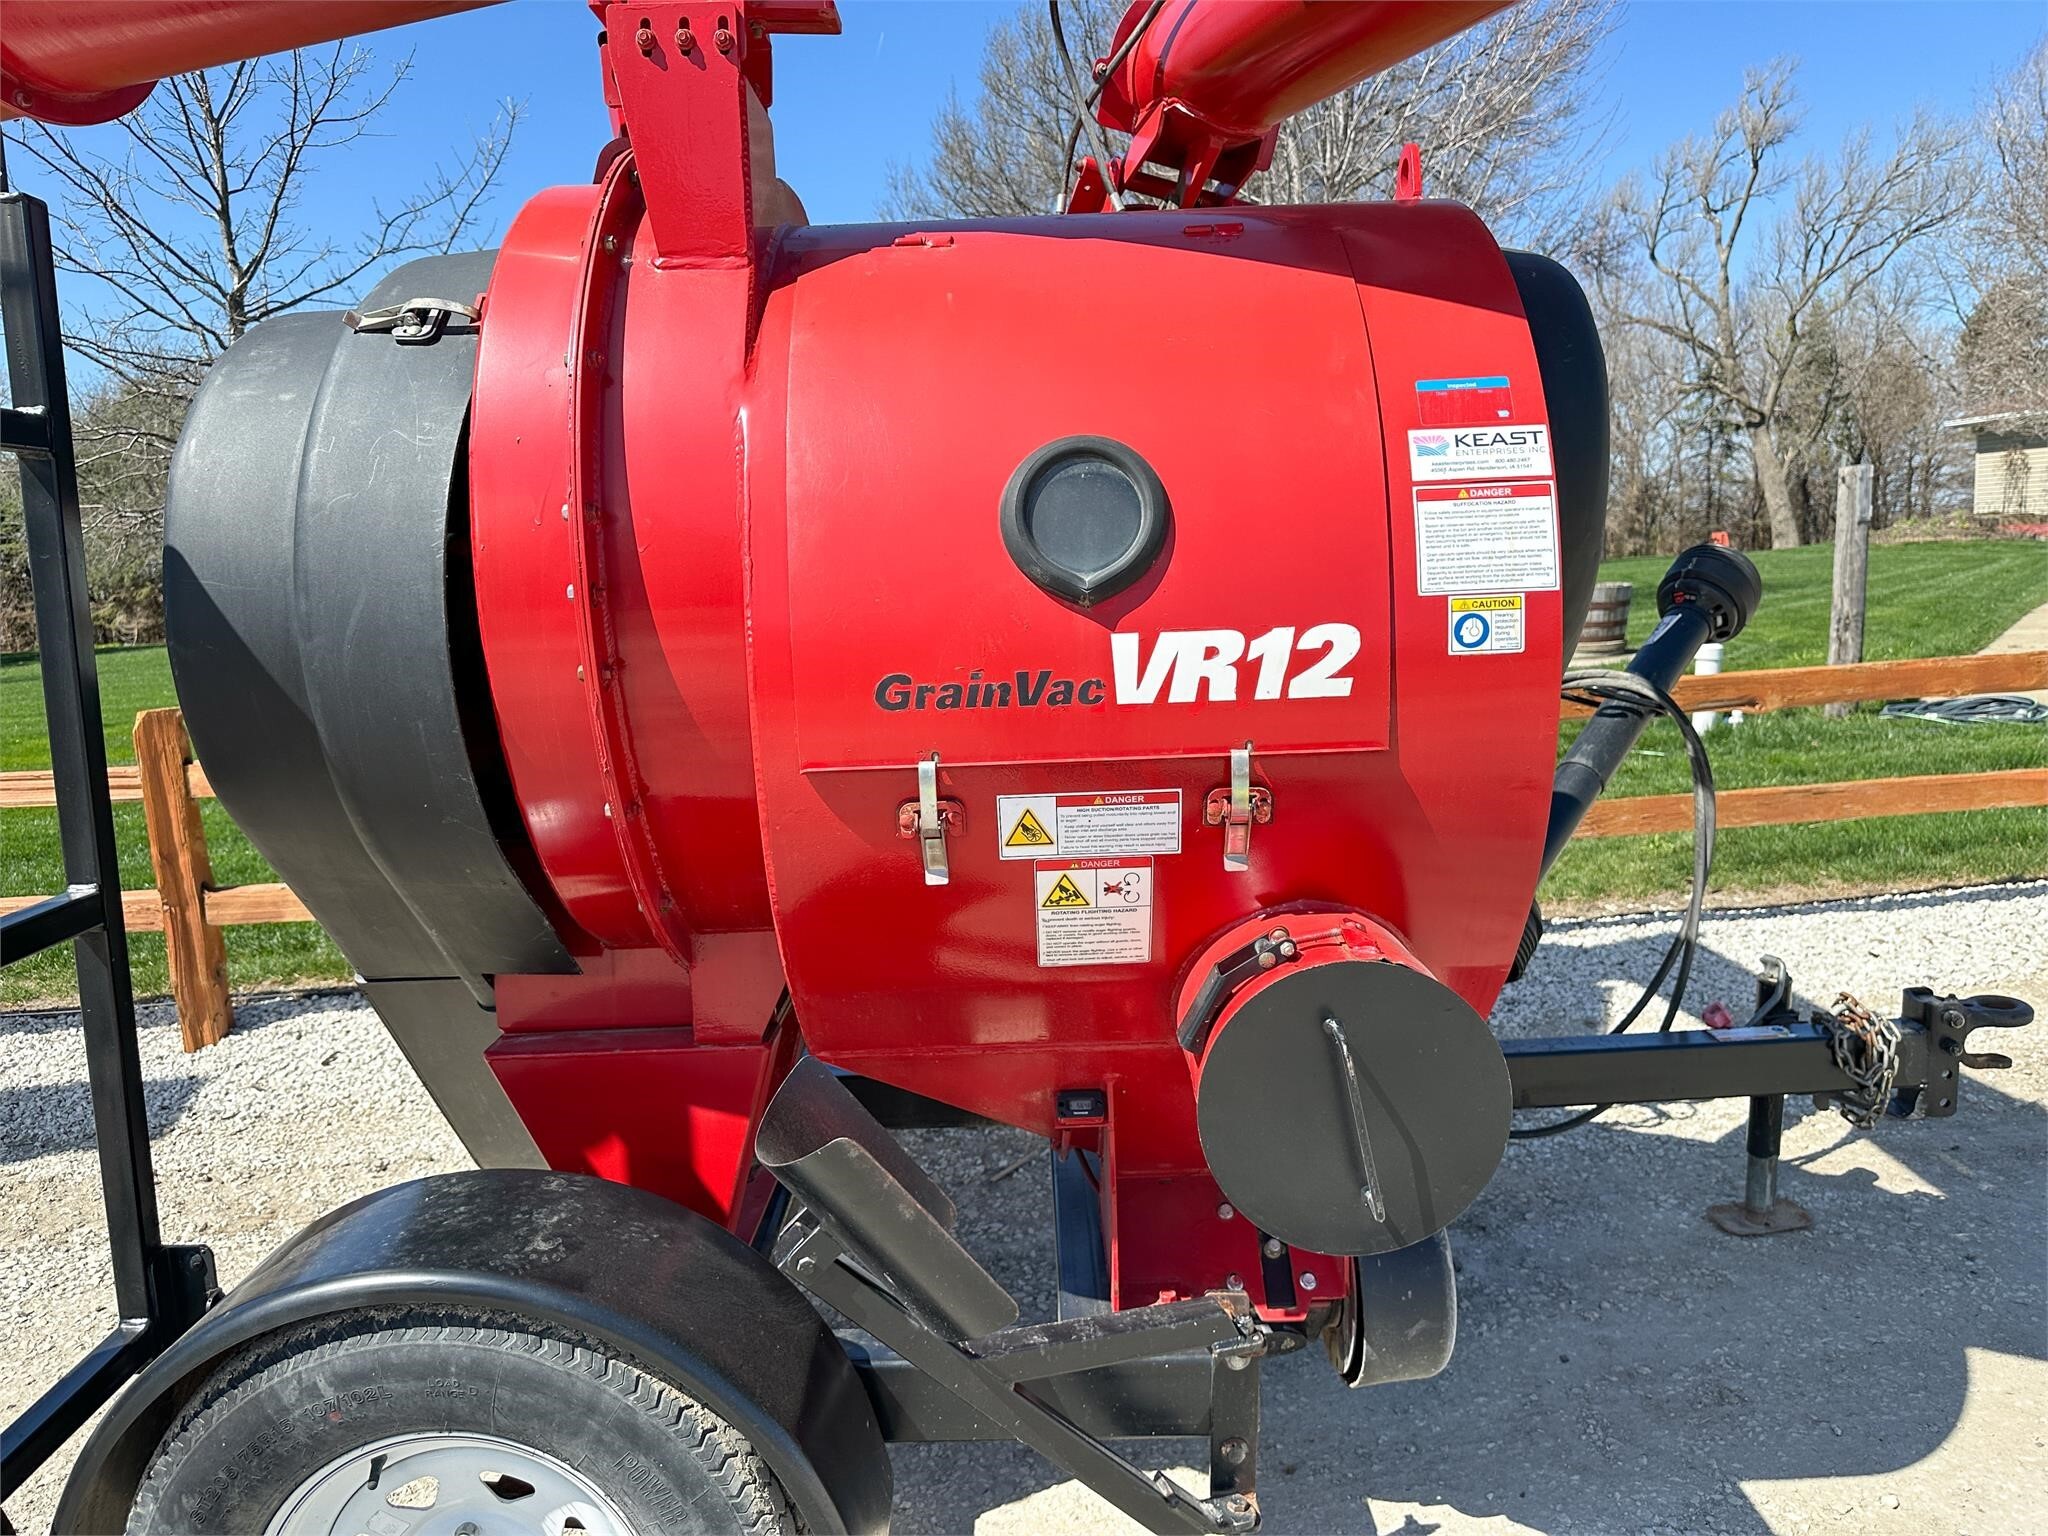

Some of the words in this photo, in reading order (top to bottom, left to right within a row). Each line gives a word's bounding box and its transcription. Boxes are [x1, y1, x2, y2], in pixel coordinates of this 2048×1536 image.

[1454, 430, 1543, 448] KEAST
[1456, 447, 1525, 456] ENTERPRISES
[1528, 446, 1546, 454] INC
[1470, 487, 1512, 497] DANGER
[1452, 500, 1492, 508] SUFFOCATION
[1472, 600, 1515, 608] CAUTION
[874, 669, 1107, 711] GrainVac
[1110, 622, 1362, 705] VR12
[1105, 796, 1144, 804] DANGER
[1081, 860, 1120, 868] DANGER
[428, 1376, 460, 1388] LOAD
[424, 1388, 465, 1398] RANGE
[468, 1386, 479, 1396] D
[302, 1384, 393, 1422] 107/102L
[612, 1450, 689, 1527] POWER
